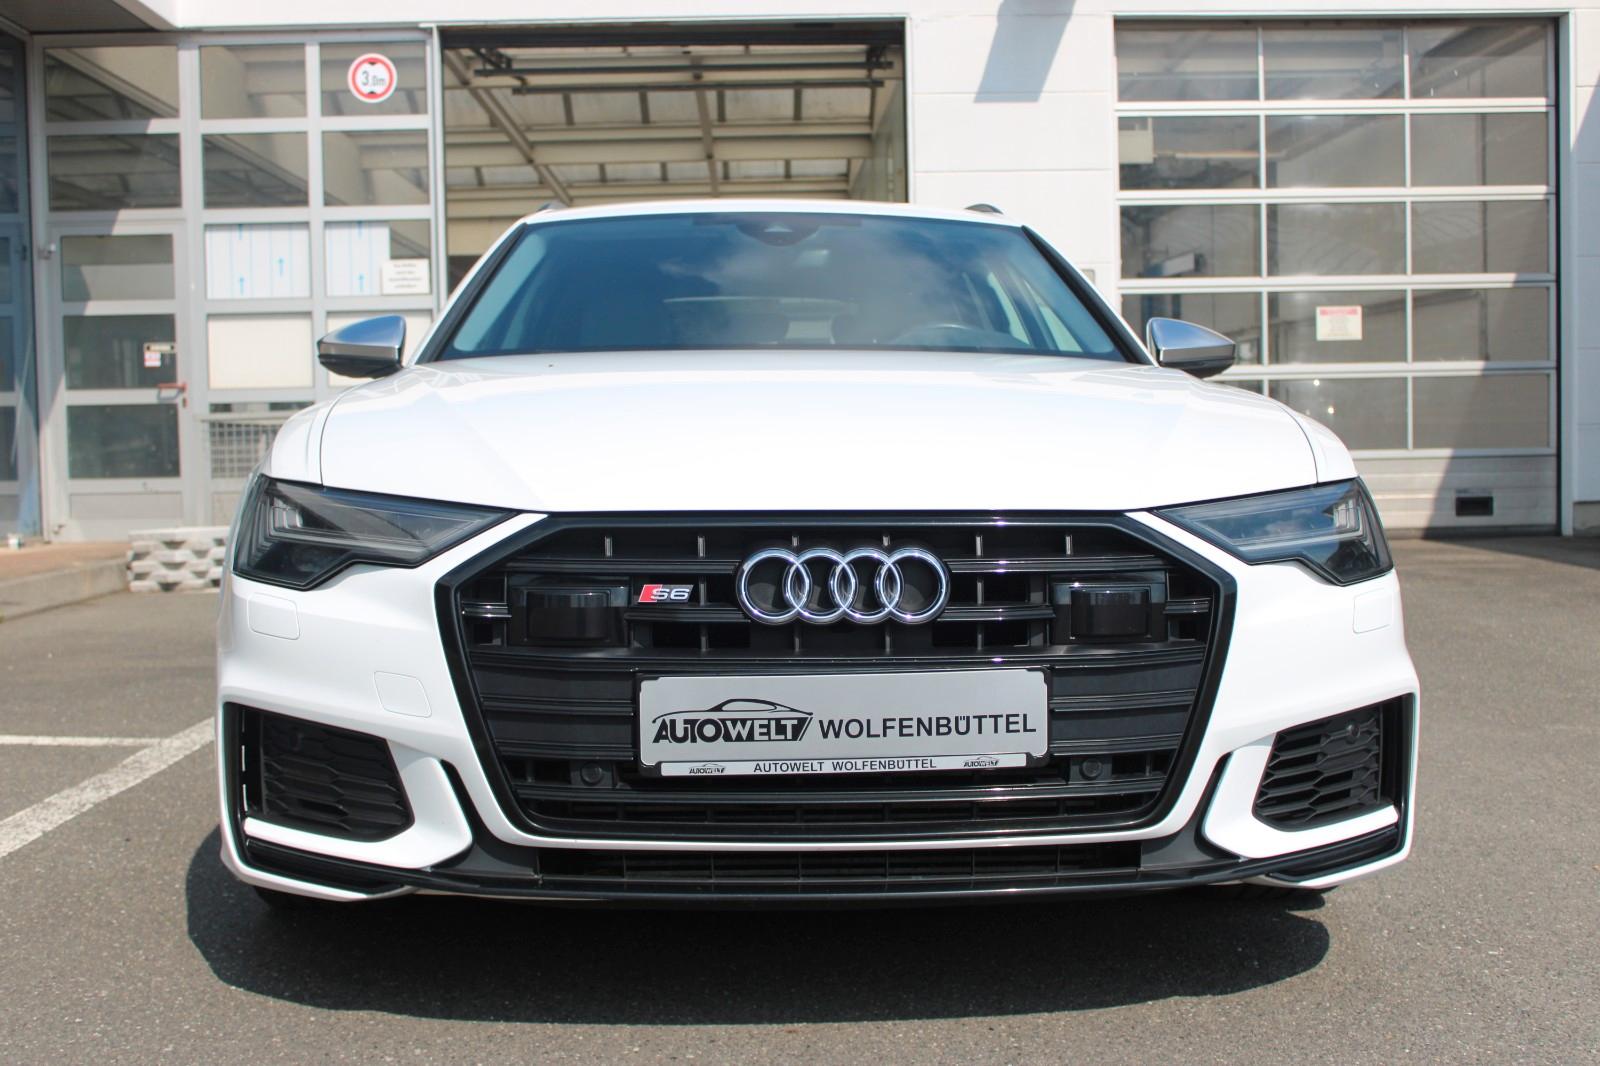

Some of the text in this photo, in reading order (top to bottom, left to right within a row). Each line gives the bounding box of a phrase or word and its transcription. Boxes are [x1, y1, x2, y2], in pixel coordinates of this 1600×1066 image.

[651, 588, 690, 600] S6
[652, 714, 1036, 743] AUTOWELT WOLFENBÜTTEL
[754, 761, 825, 773] AUTOWELT
